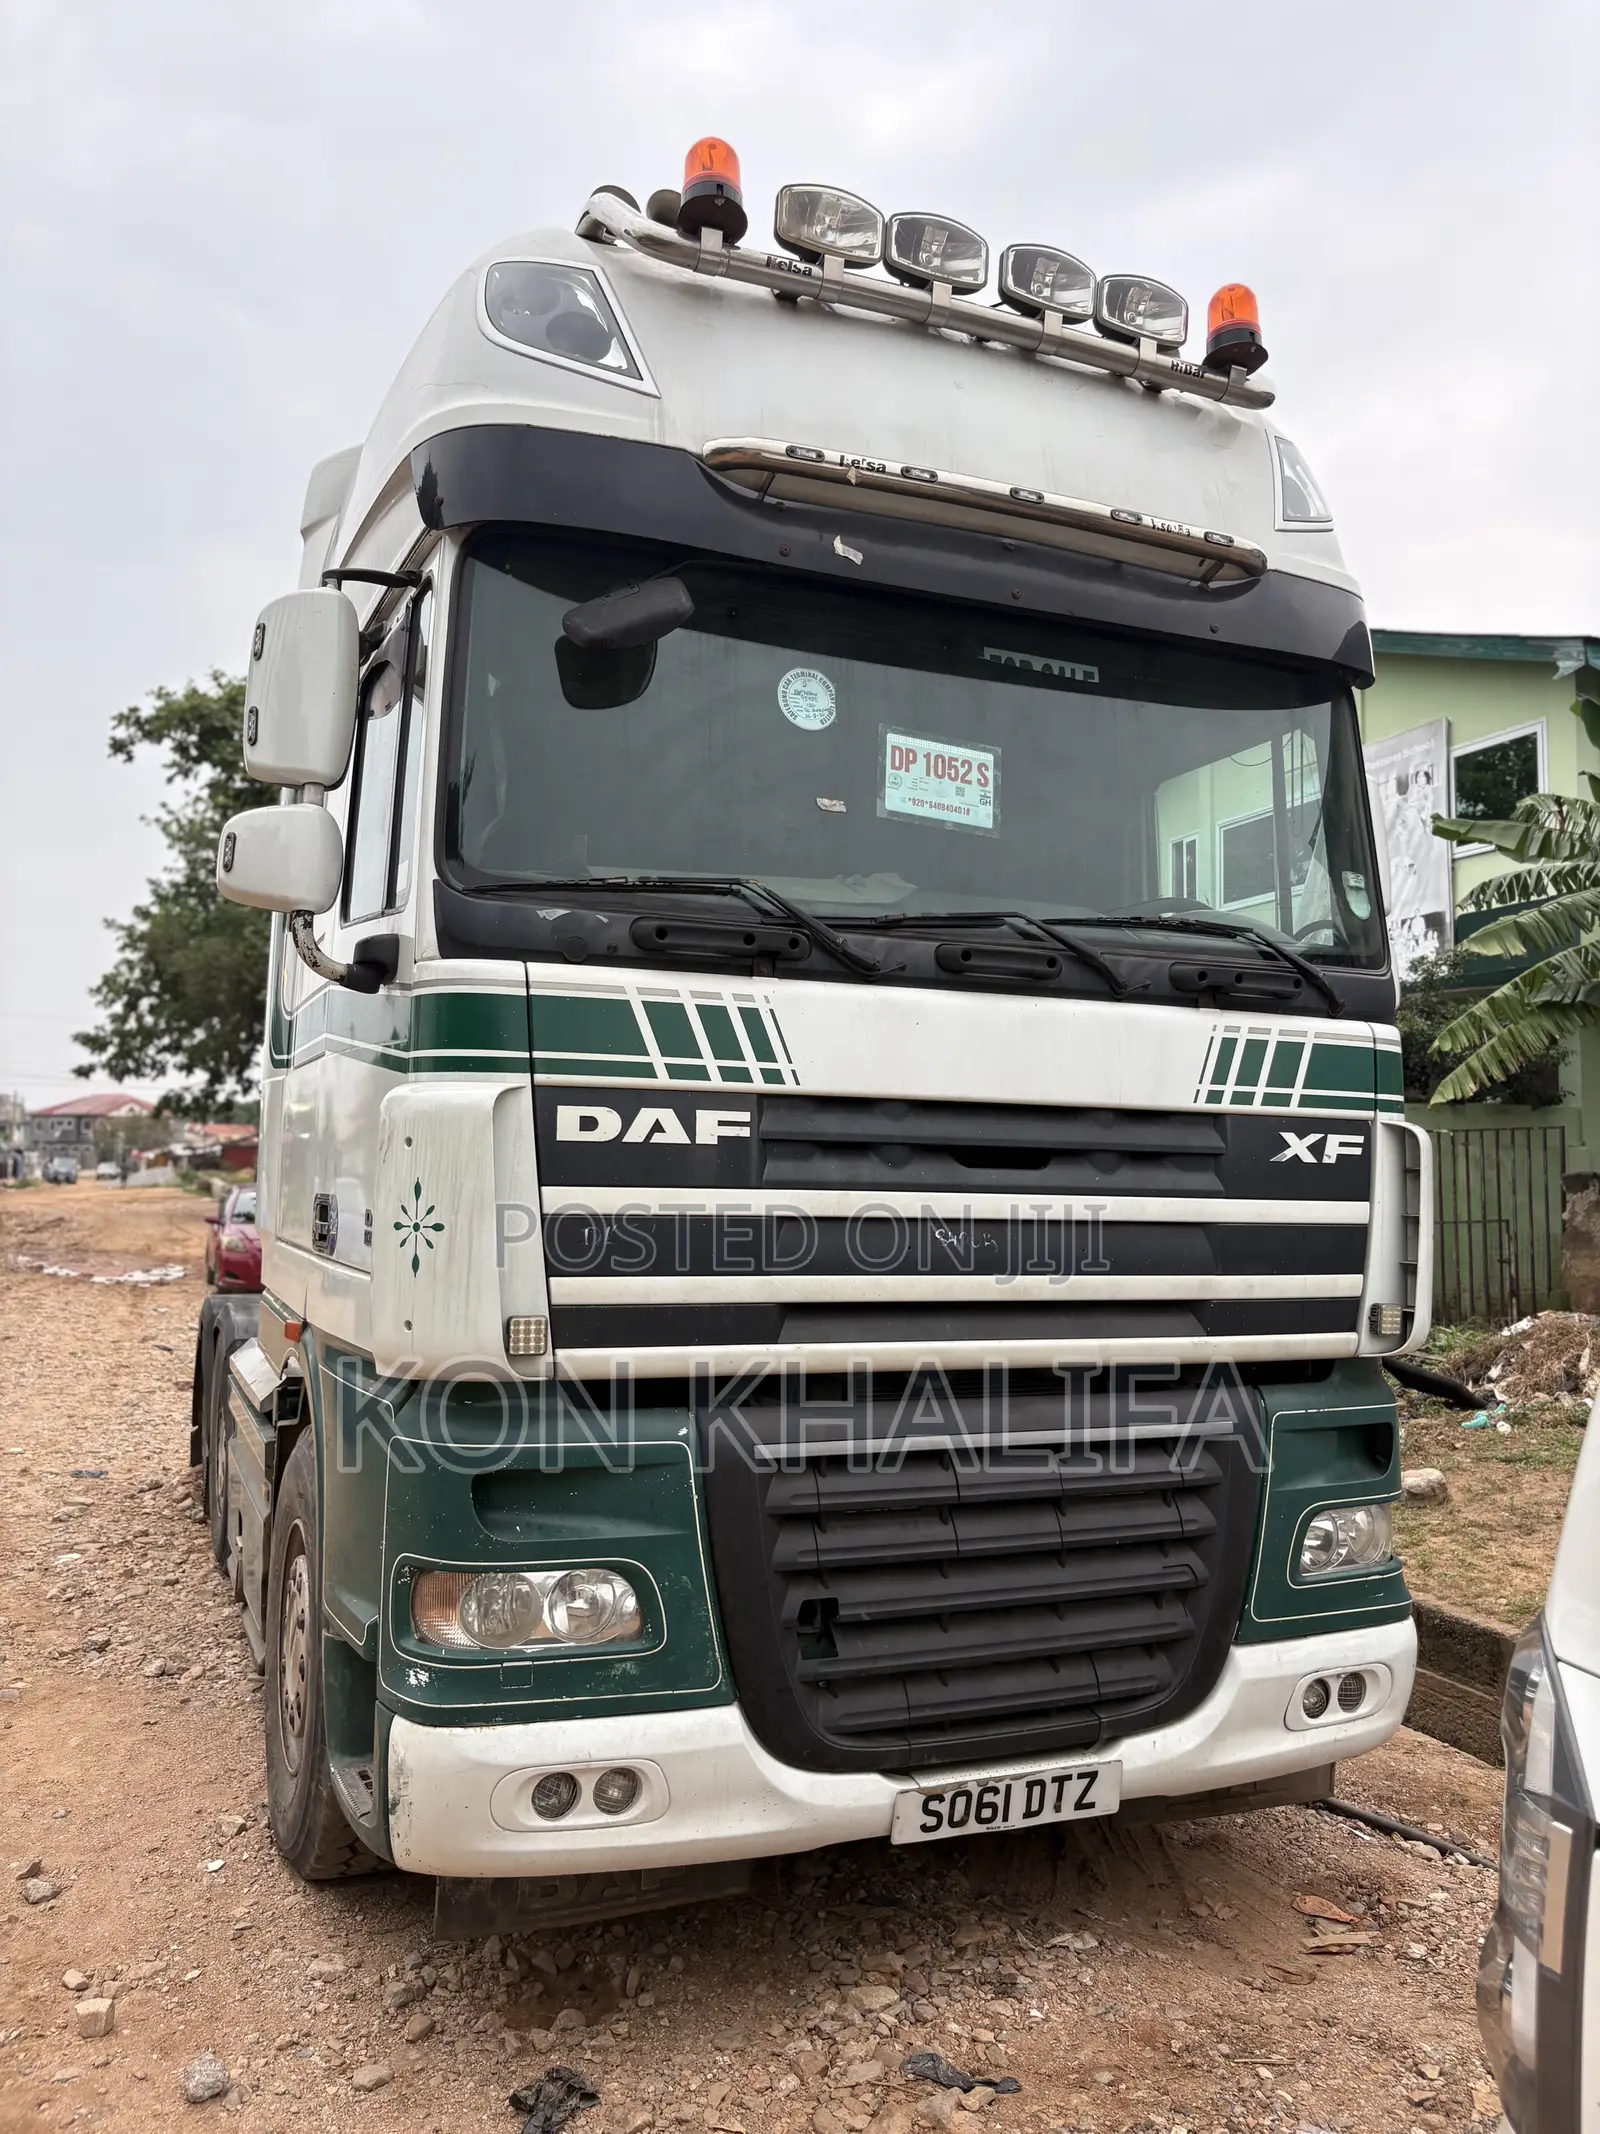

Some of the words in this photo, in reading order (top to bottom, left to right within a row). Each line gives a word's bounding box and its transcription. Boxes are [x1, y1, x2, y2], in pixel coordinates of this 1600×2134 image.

[782, 678, 793, 690] CAR
[790, 670, 819, 681] TERMINAL
[818, 677, 836, 704] COMPANY
[819, 705, 836, 726] LIMITED
[890, 744, 918, 774] DP
[923, 751, 973, 785] 1052
[976, 762, 990, 788] S
[979, 798, 992, 807] GH
[556, 1104, 751, 1145] DAF
[1269, 1131, 1365, 1165] XF
[919, 1783, 1013, 1834] SO61
[1022, 1770, 1099, 1820] DTZ
